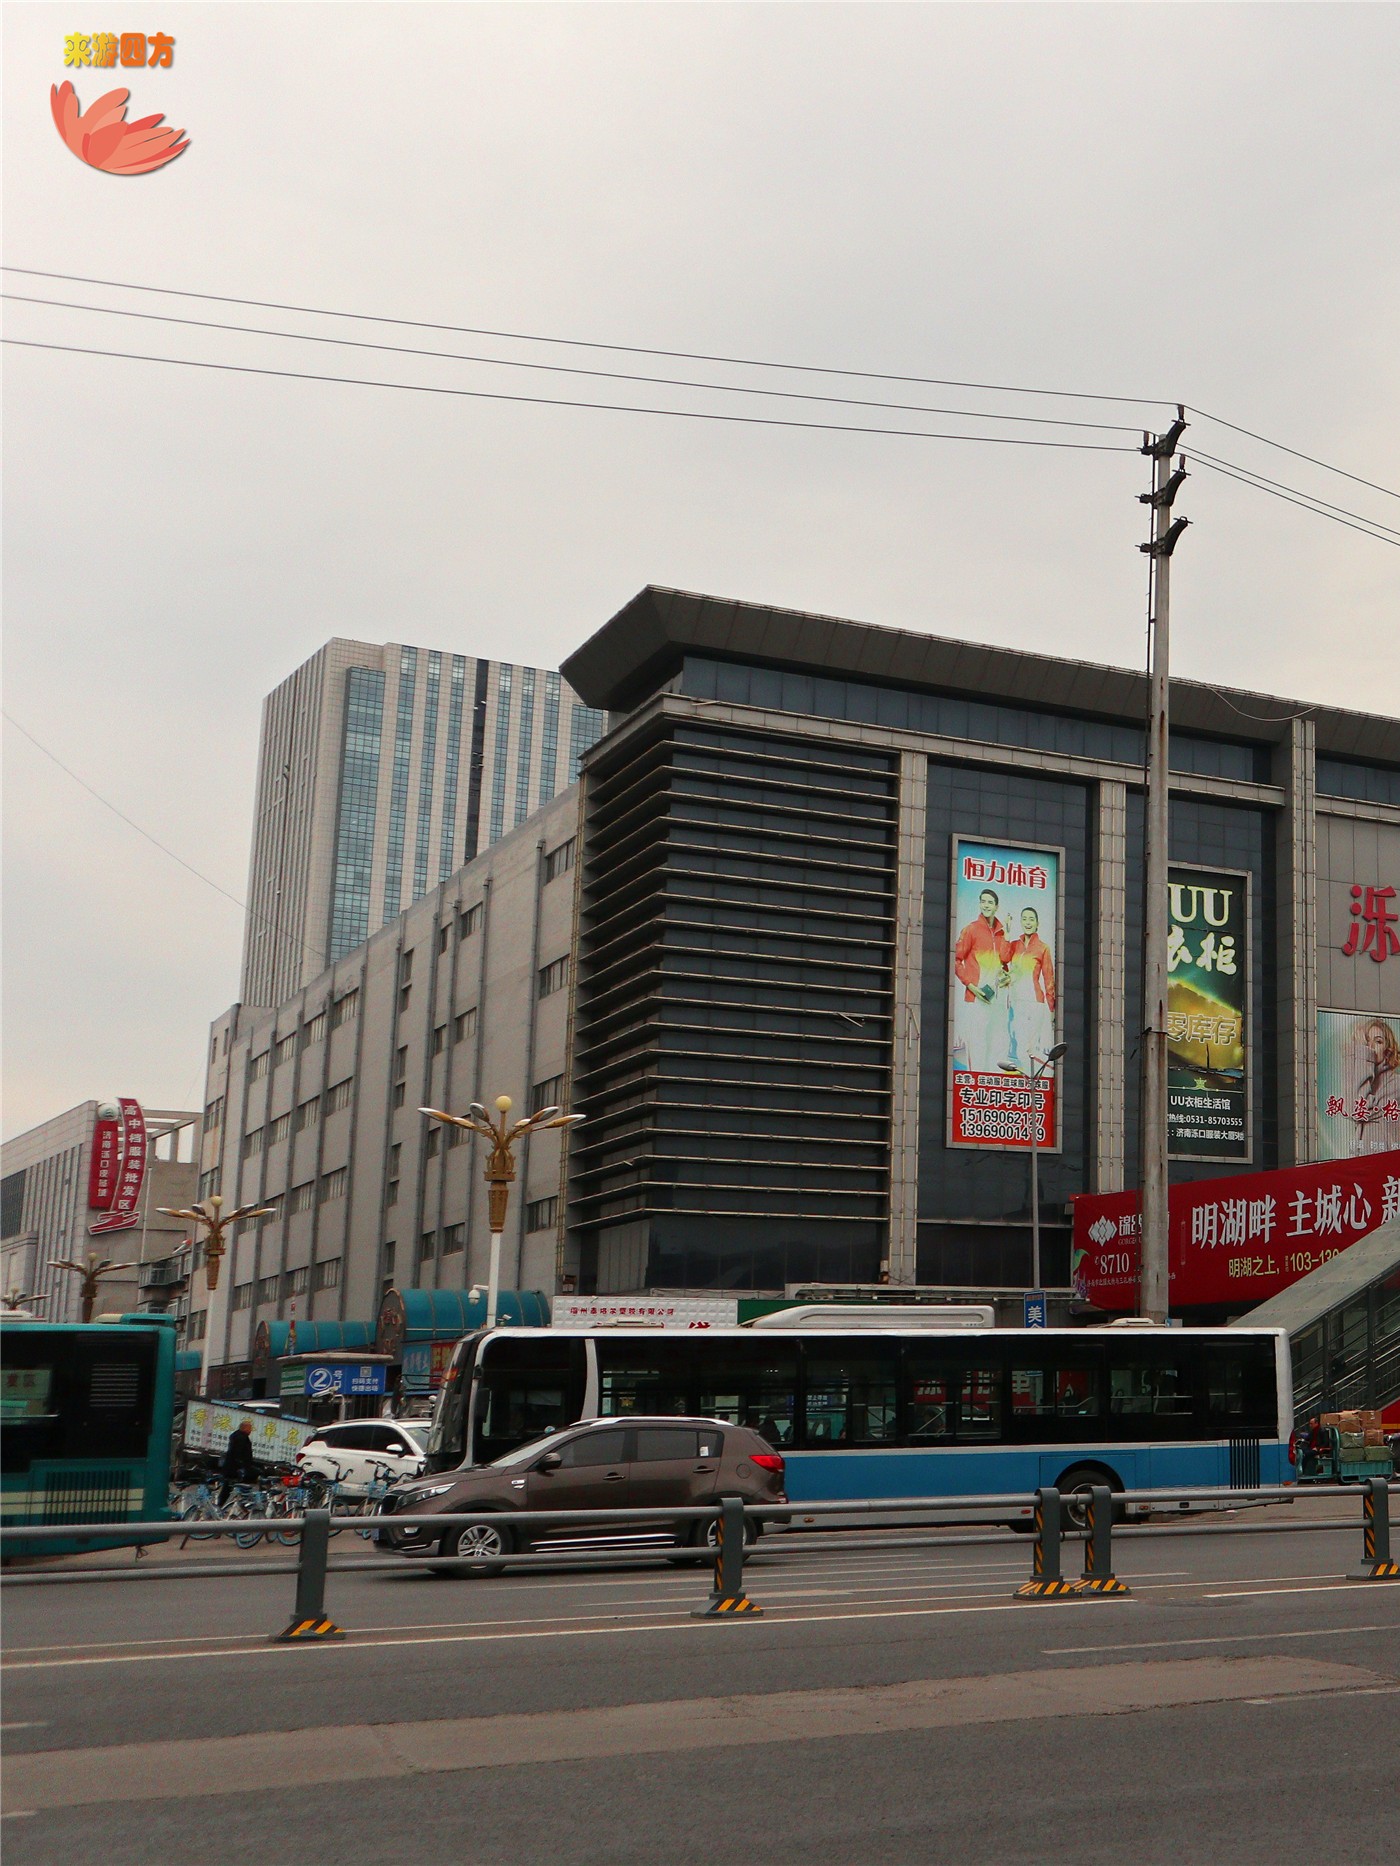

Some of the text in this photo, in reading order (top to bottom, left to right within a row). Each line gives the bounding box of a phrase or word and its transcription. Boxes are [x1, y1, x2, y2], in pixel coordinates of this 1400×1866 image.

[963, 857, 1048, 890] 恒力体育
[1168, 882, 1233, 927] UU
[960, 1087, 1045, 1110] 专业印字印号
[1170, 1095, 1231, 1110] UU衣柜生活馆
[960, 1123, 1045, 1141] 1396900149
[1167, 1113, 1243, 1126] 热线:0531-85703555
[118, 1105, 143, 1210] 高中档服装批发区
[1191, 1195, 1278, 1249] 明湖畔
[1286, 1182, 1372, 1238] 主城心
